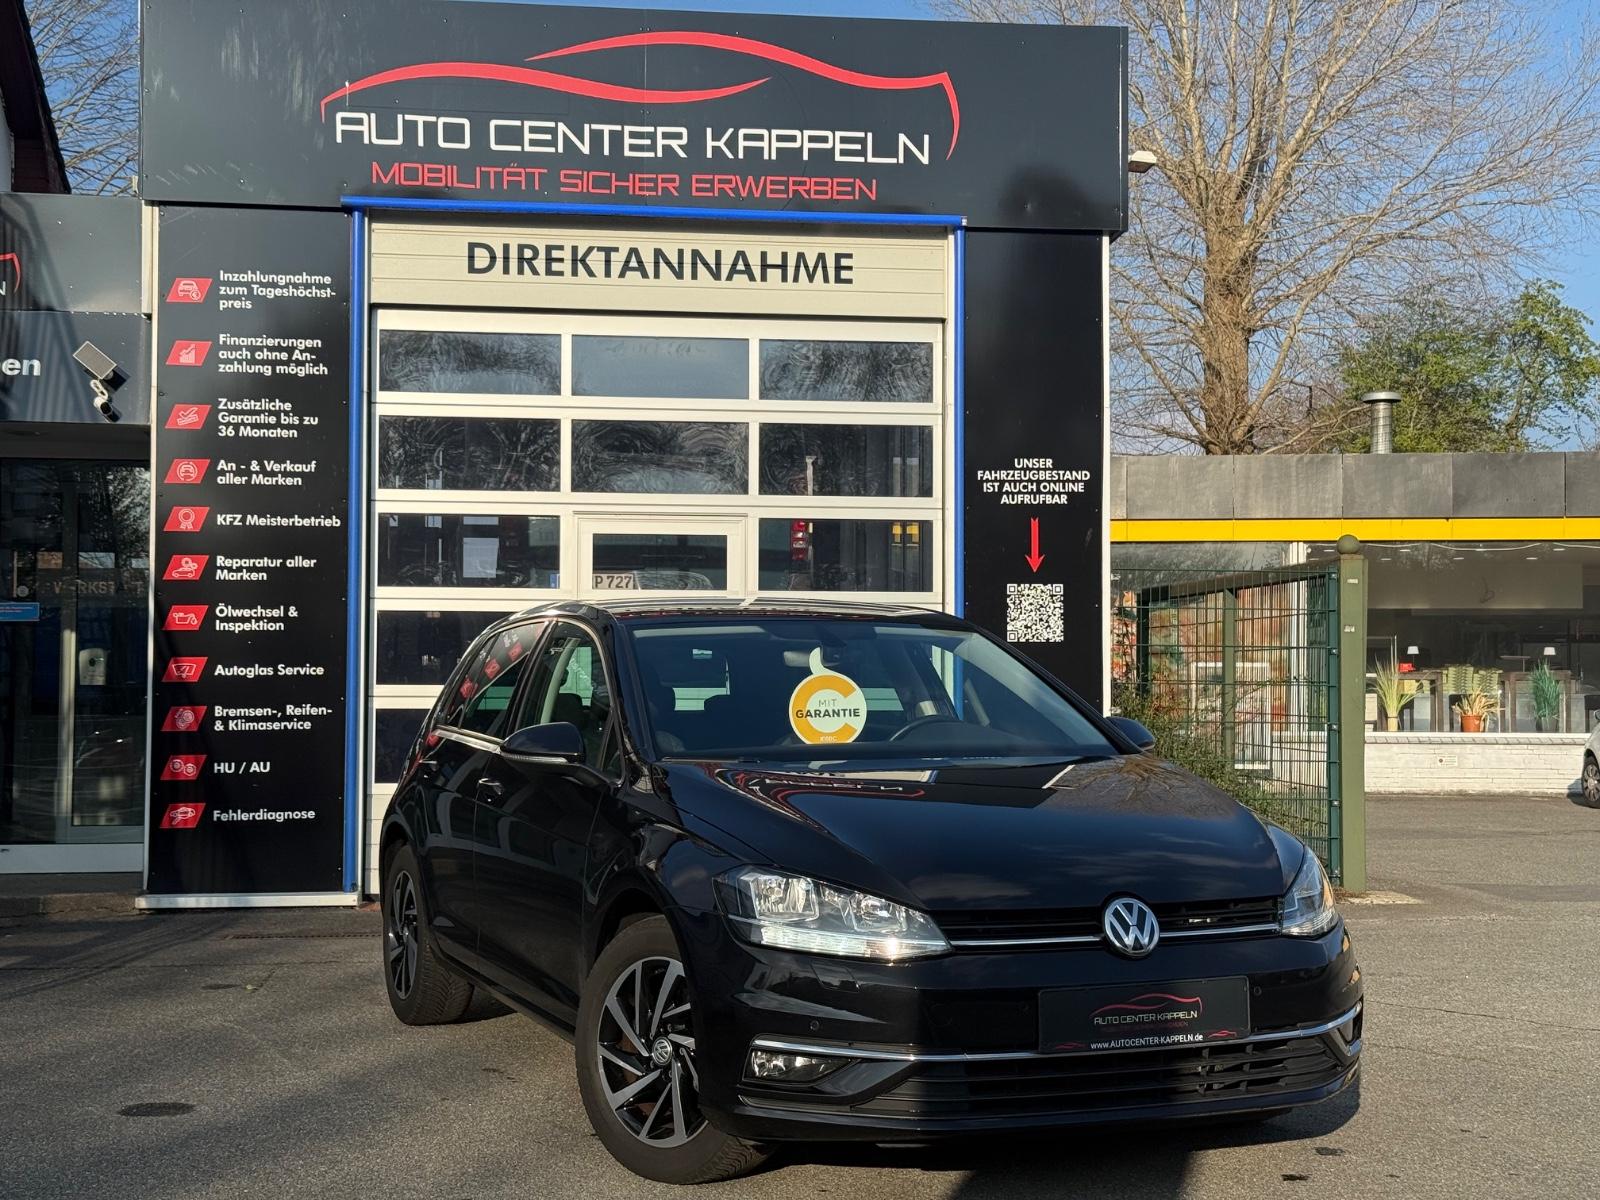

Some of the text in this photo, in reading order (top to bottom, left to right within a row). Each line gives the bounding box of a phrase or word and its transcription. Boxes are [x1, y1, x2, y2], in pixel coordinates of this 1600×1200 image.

[335, 111, 930, 165] AUTO CENTER KAPPELN
[372, 160, 877, 201] MOBILITÄT SICHER ERWERBEN
[467, 241, 854, 285] DIREKTANNAHME
[220, 270, 332, 286] Inzahlungnahme
[219, 284, 336, 298] zum Tageshöchst-
[220, 297, 252, 310] preis
[219, 334, 322, 350] Finanzierungen
[218, 348, 316, 361] auch ohne An-
[0, 358, 41, 376] en
[218, 361, 328, 377] zahlung möglich
[218, 398, 292, 411] Zusätzliche
[218, 412, 318, 426] Garantie bis zu
[218, 426, 298, 438] 36 Monaten
[250, 460, 260, 472] &
[264, 460, 316, 472] Verkauf
[1014, 458, 1053, 469] UNSER
[216, 472, 302, 486] aller Marken
[977, 470, 1090, 481] FAHRZEUGBESTAND
[983, 482, 1085, 493] IST AUCH ONLINE
[1000, 494, 1068, 505] AUFRUFBAR
[216, 514, 341, 528] KFZ Meisterbetrieb
[216, 555, 317, 570] Reparatur aller
[215, 568, 268, 580] Marken
[606, 575, 632, 588] 727
[215, 602, 298, 618] Ölwechsel &
[215, 618, 284, 634] Inspektion
[214, 663, 324, 678] Autoglas Service
[818, 699, 837, 708] MIT
[214, 704, 333, 718] Bremsen-, Reifen-
[796, 708, 860, 719] GARANTIE
[214, 718, 312, 731] & Klimaservice
[214, 761, 271, 774] HU / AU
[213, 808, 316, 822] Fehlerdiagnose
[1094, 1010, 1198, 1026] AUTO CENTER KAPPELN
[1090, 1033, 1204, 1049] www.AUTOCENTER-KAPPELN.de
